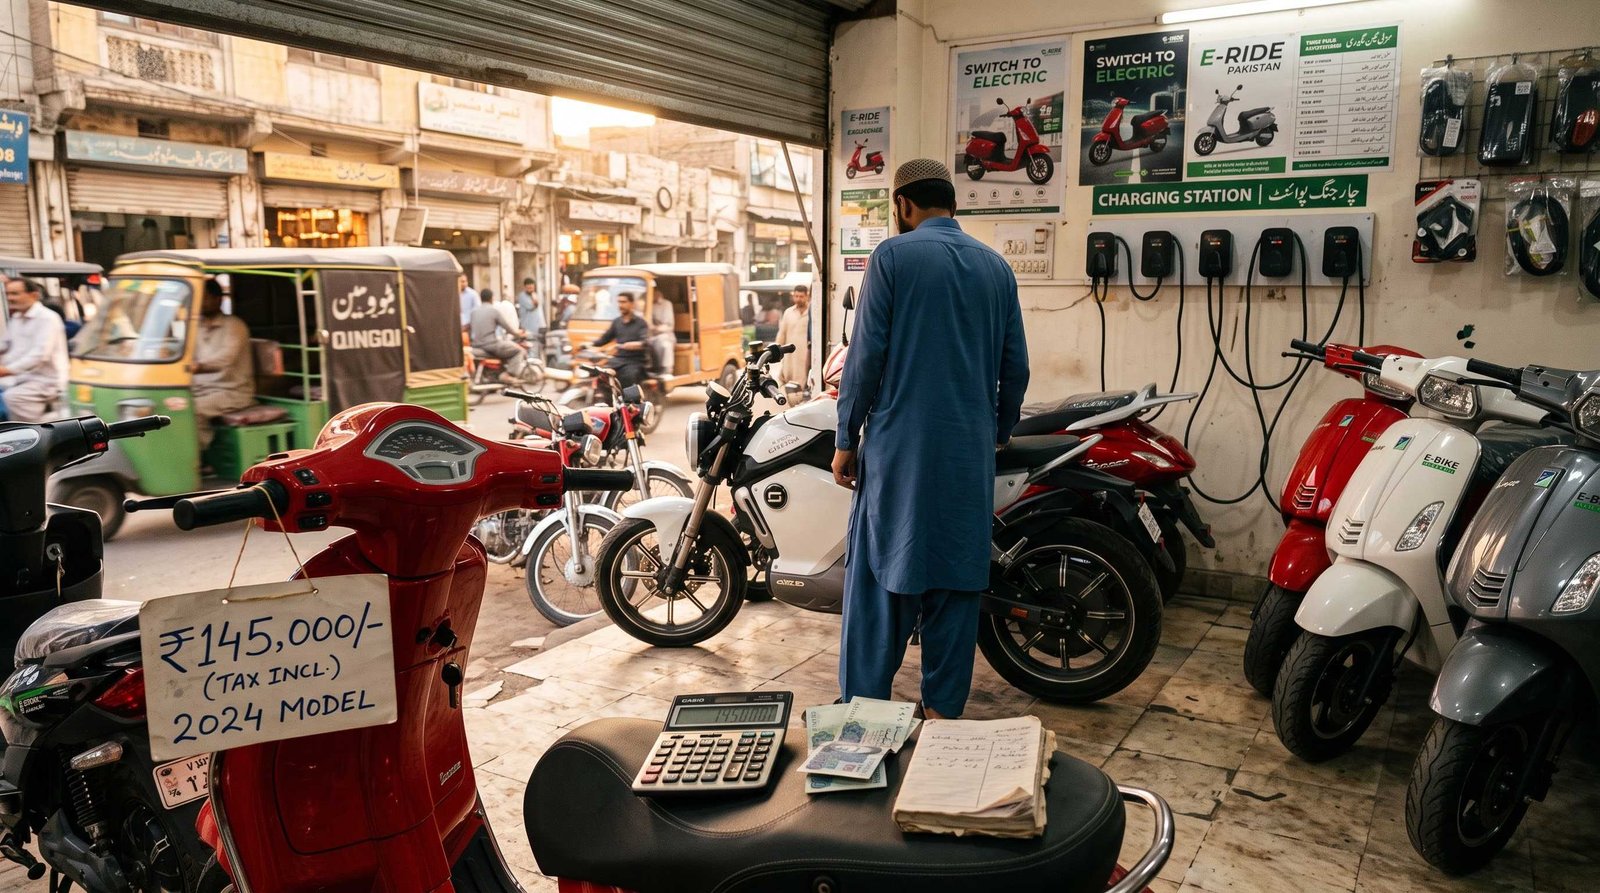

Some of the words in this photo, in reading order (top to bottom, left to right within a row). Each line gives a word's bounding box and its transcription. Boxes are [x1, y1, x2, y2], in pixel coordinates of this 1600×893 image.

[1096, 52, 1152, 68] SWITCH
[1155, 50, 1176, 62] TO
[1200, 42, 1285, 66] E-RIDE
[964, 59, 1019, 76] SWITCH
[1023, 57, 1041, 69] TO
[1096, 64, 1175, 83] ELECTRIC
[1227, 62, 1281, 75] PAKISTAN
[973, 70, 1048, 89] ELECTRIC
[850, 112, 881, 122] E-RIDE
[1098, 190, 1180, 206] CHARGING
[1183, 188, 1252, 204] STATION
[331, 328, 402, 350] QINGQI
[1423, 453, 1460, 470] E-BIKE
[1577, 492, 1600, 505] E-B
[203, 671, 260, 701] (TAX
[268, 654, 341, 686] INCL.)
[173, 702, 263, 745] 2024
[280, 689, 375, 723] MODEL
